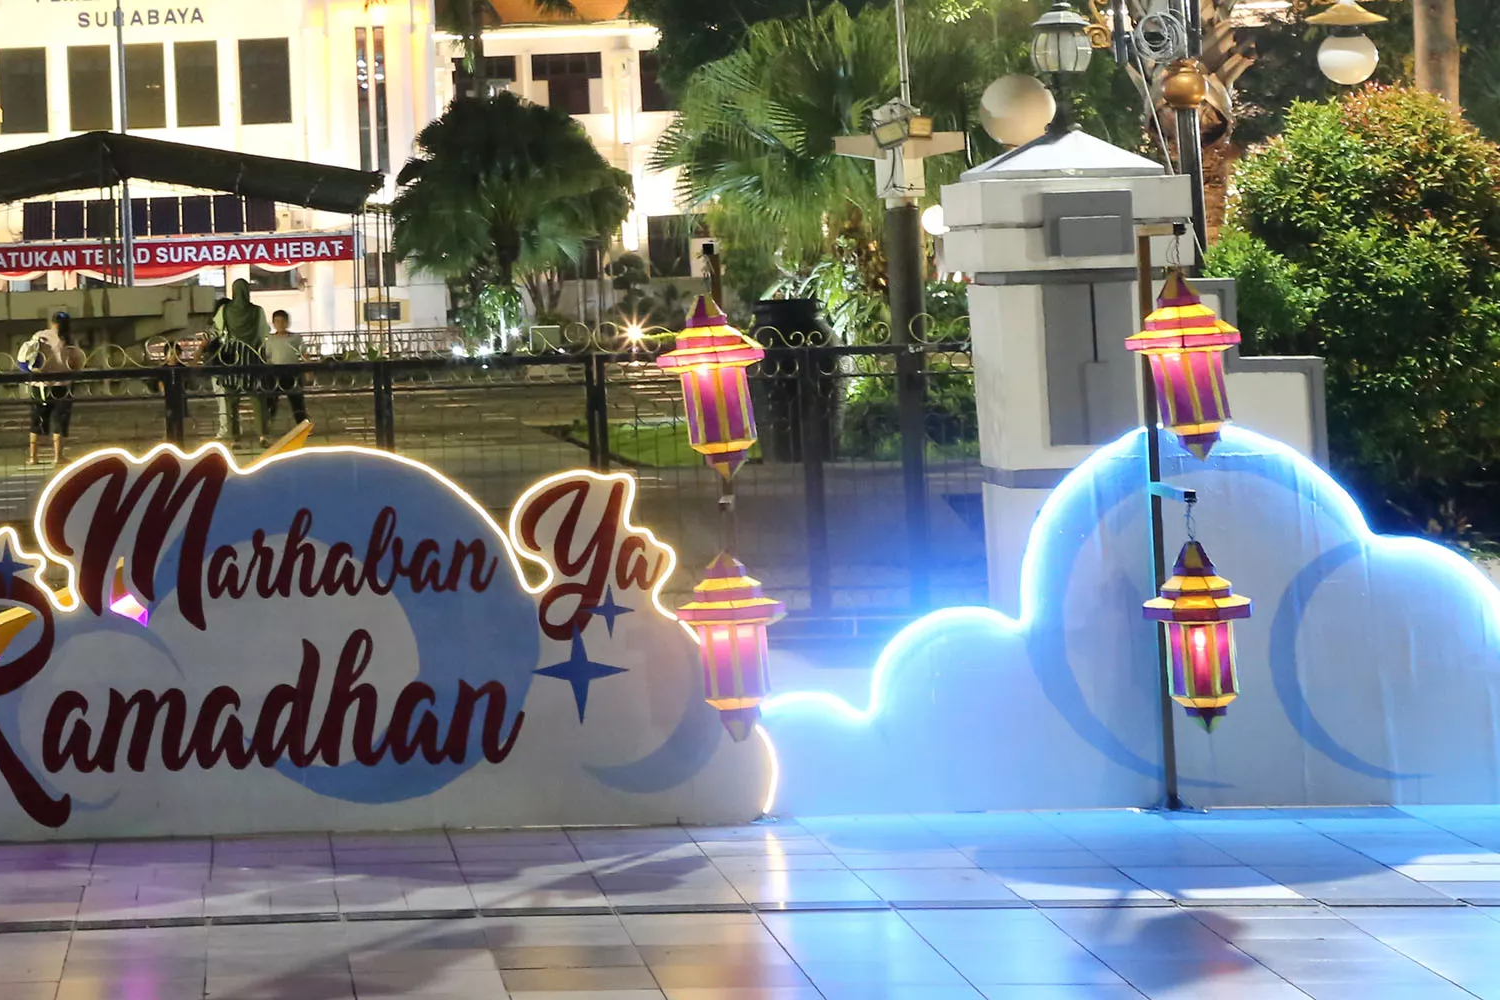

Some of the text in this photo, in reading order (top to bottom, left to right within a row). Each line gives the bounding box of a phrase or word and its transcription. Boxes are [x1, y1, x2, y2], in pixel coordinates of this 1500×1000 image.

[155, 243, 270, 263] SURABAYA
[274, 239, 344, 259] HEBAT
[40, 454, 664, 641] Marhaban Ya
